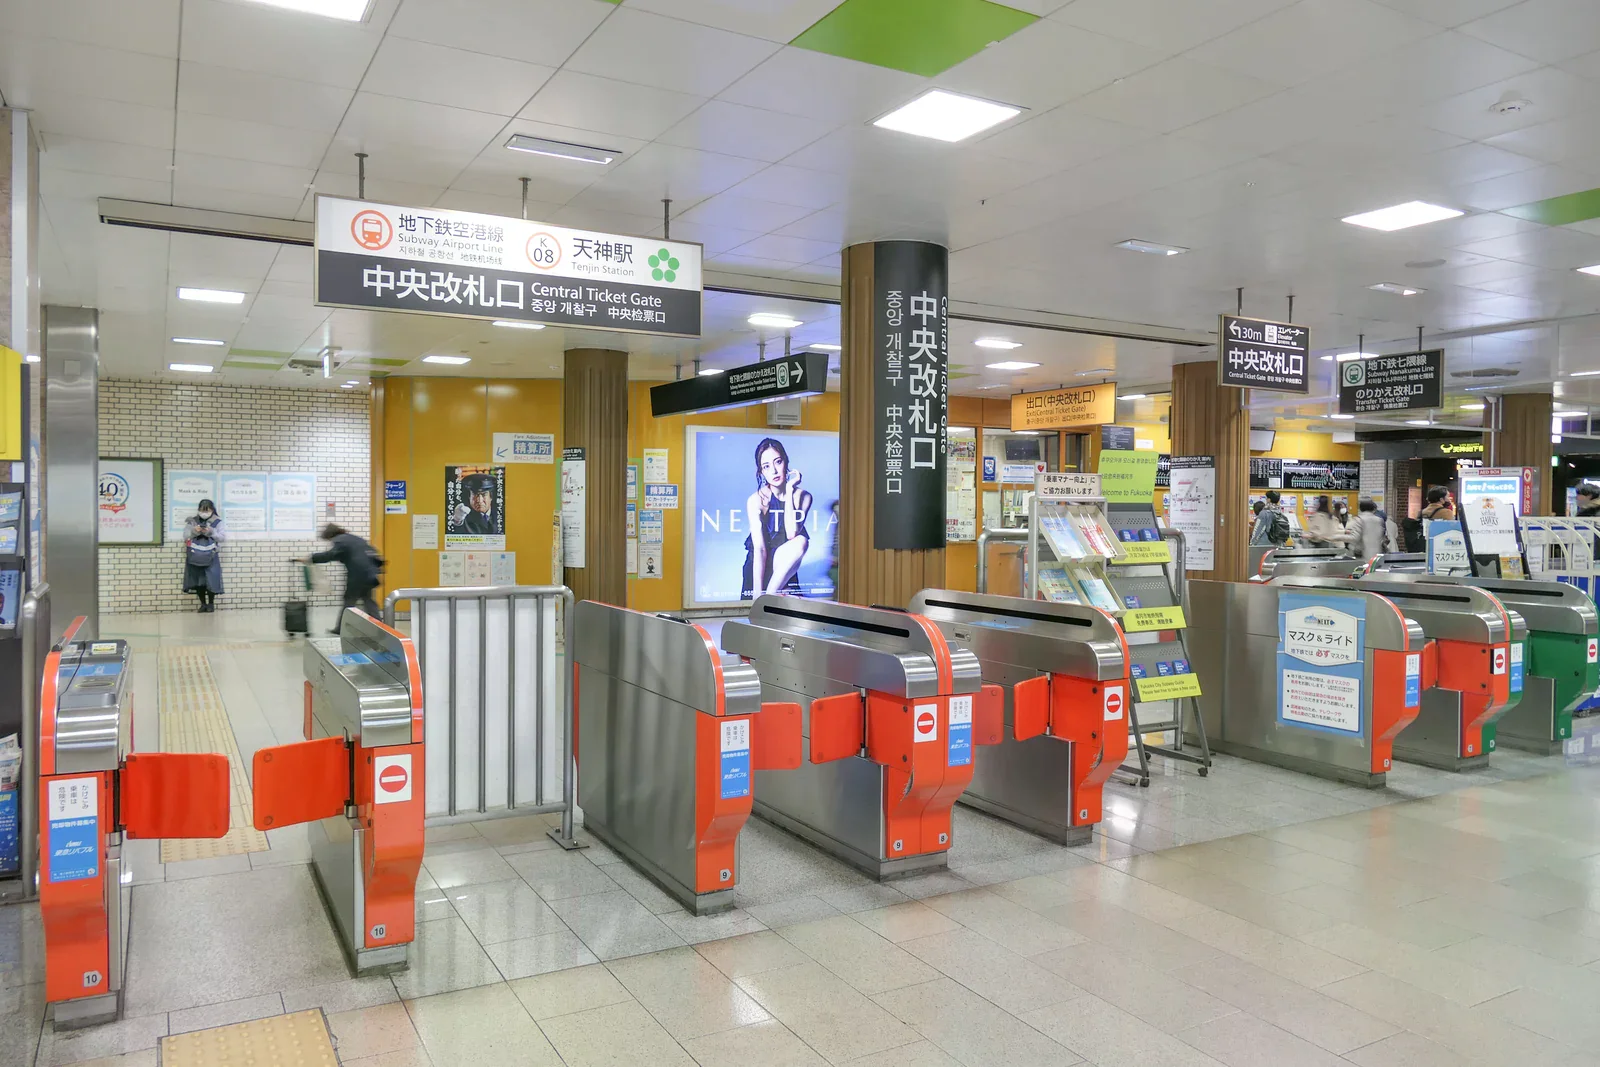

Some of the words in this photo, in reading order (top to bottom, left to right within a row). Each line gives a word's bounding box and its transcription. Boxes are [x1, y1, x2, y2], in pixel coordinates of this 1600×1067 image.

[399, 213, 504, 242] 地下鉄空港線
[398, 233, 439, 248] Subway
[442, 238, 480, 251] Airport
[482, 243, 503, 253] Line
[540, 237, 548, 248] K
[572, 237, 633, 264] 天神駅
[399, 246, 425, 257] 지하철
[533, 247, 554, 264] 08
[571, 261, 600, 274] Tenjin
[602, 264, 635, 277] Station
[363, 264, 525, 310] 中央改札口
[531, 282, 582, 299] Central
[585, 287, 627, 304] Ticket
[630, 292, 662, 308] Gate
[530, 298, 557, 314] 중앙
[560, 301, 598, 317] 개찰구
[608, 306, 666, 324] 中央检票口
[886, 290, 904, 327] 중앙
[1242, 327, 1262, 341] 30m
[1277, 326, 1304, 336] エレベーター
[886, 332, 904, 387] 개찰구
[1229, 347, 1303, 376] 中央改札口
[1368, 354, 1427, 371] 地下鉄七隈線
[1390, 367, 1420, 375] Nanakuma
[908, 290, 938, 470] 中央改札口
[1356, 384, 1423, 399] のりかえ改札口
[1055, 406, 1070, 414] Ticket
[1071, 405, 1086, 413] Gate)
[515, 442, 551, 454] 精算所
[886, 404, 904, 494] 中央检票口
[650, 485, 674, 495] 精算所
[701, 509, 838, 533] NETPIA
[52, 819, 96, 829] 売却物件募集中
[54, 846, 95, 857] 東急リバブル
[722, 871, 728, 879] 9
[375, 927, 384, 936] 10
[86, 974, 98, 984] 10
